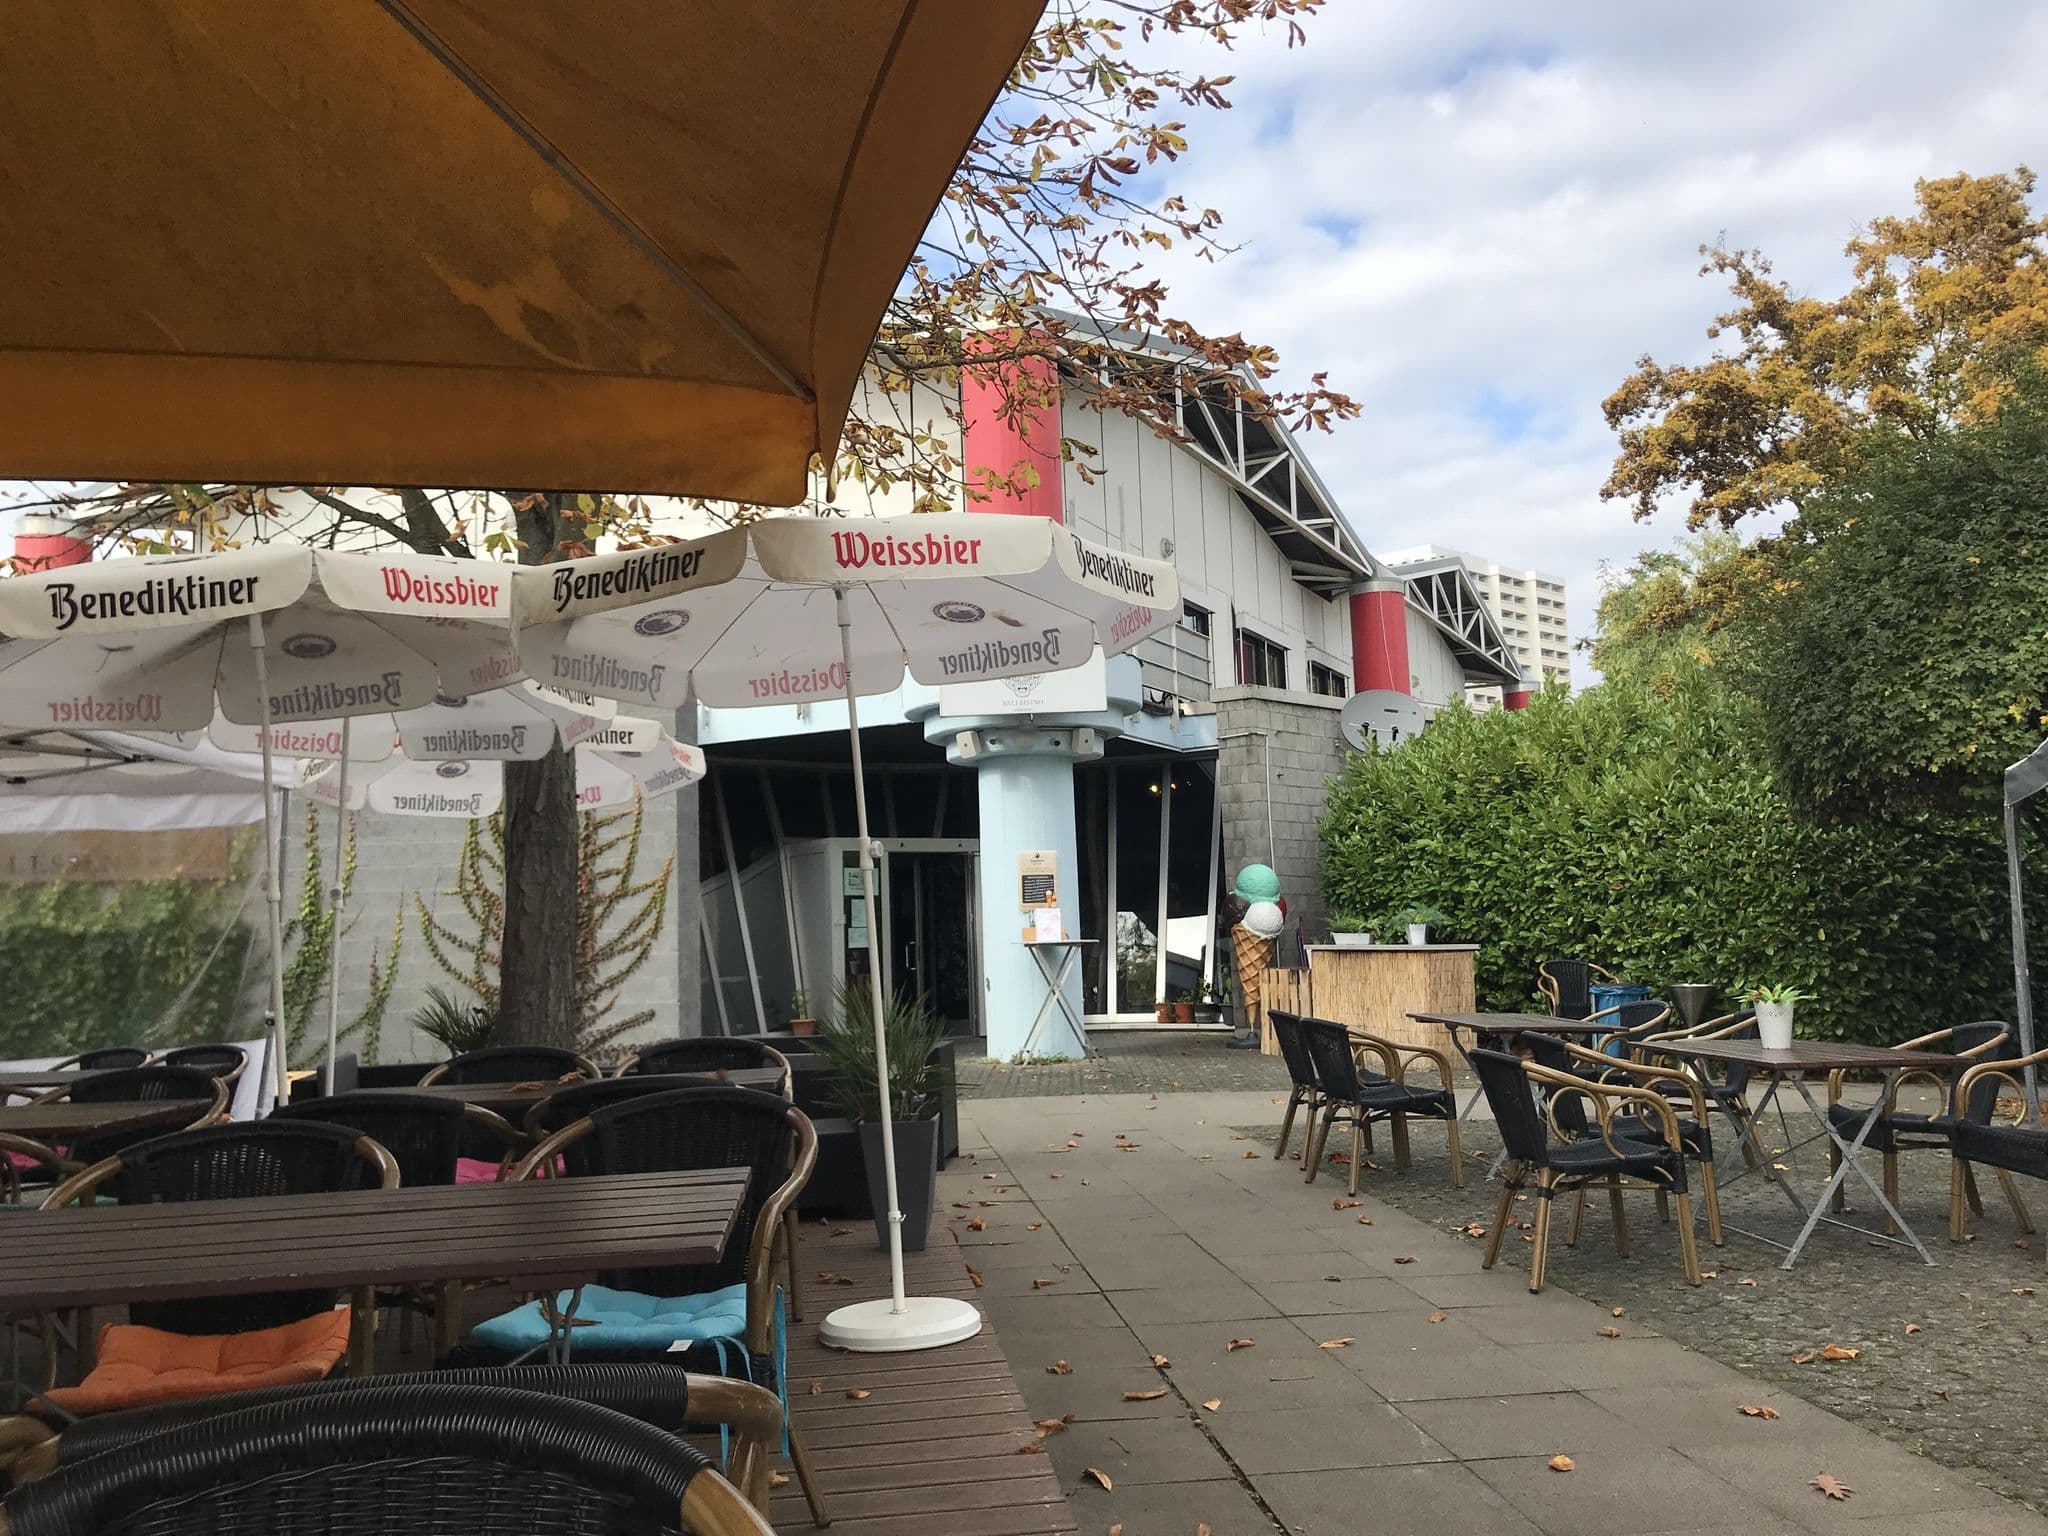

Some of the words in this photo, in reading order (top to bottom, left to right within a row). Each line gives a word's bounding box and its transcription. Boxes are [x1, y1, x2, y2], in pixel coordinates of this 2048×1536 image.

[831, 531, 982, 569] Weissbier
[1070, 533, 1155, 598] Benediktiner
[44, 575, 259, 631] Benediktiner
[380, 566, 499, 608] Weissbier
[552, 547, 705, 613] Benediktiner
